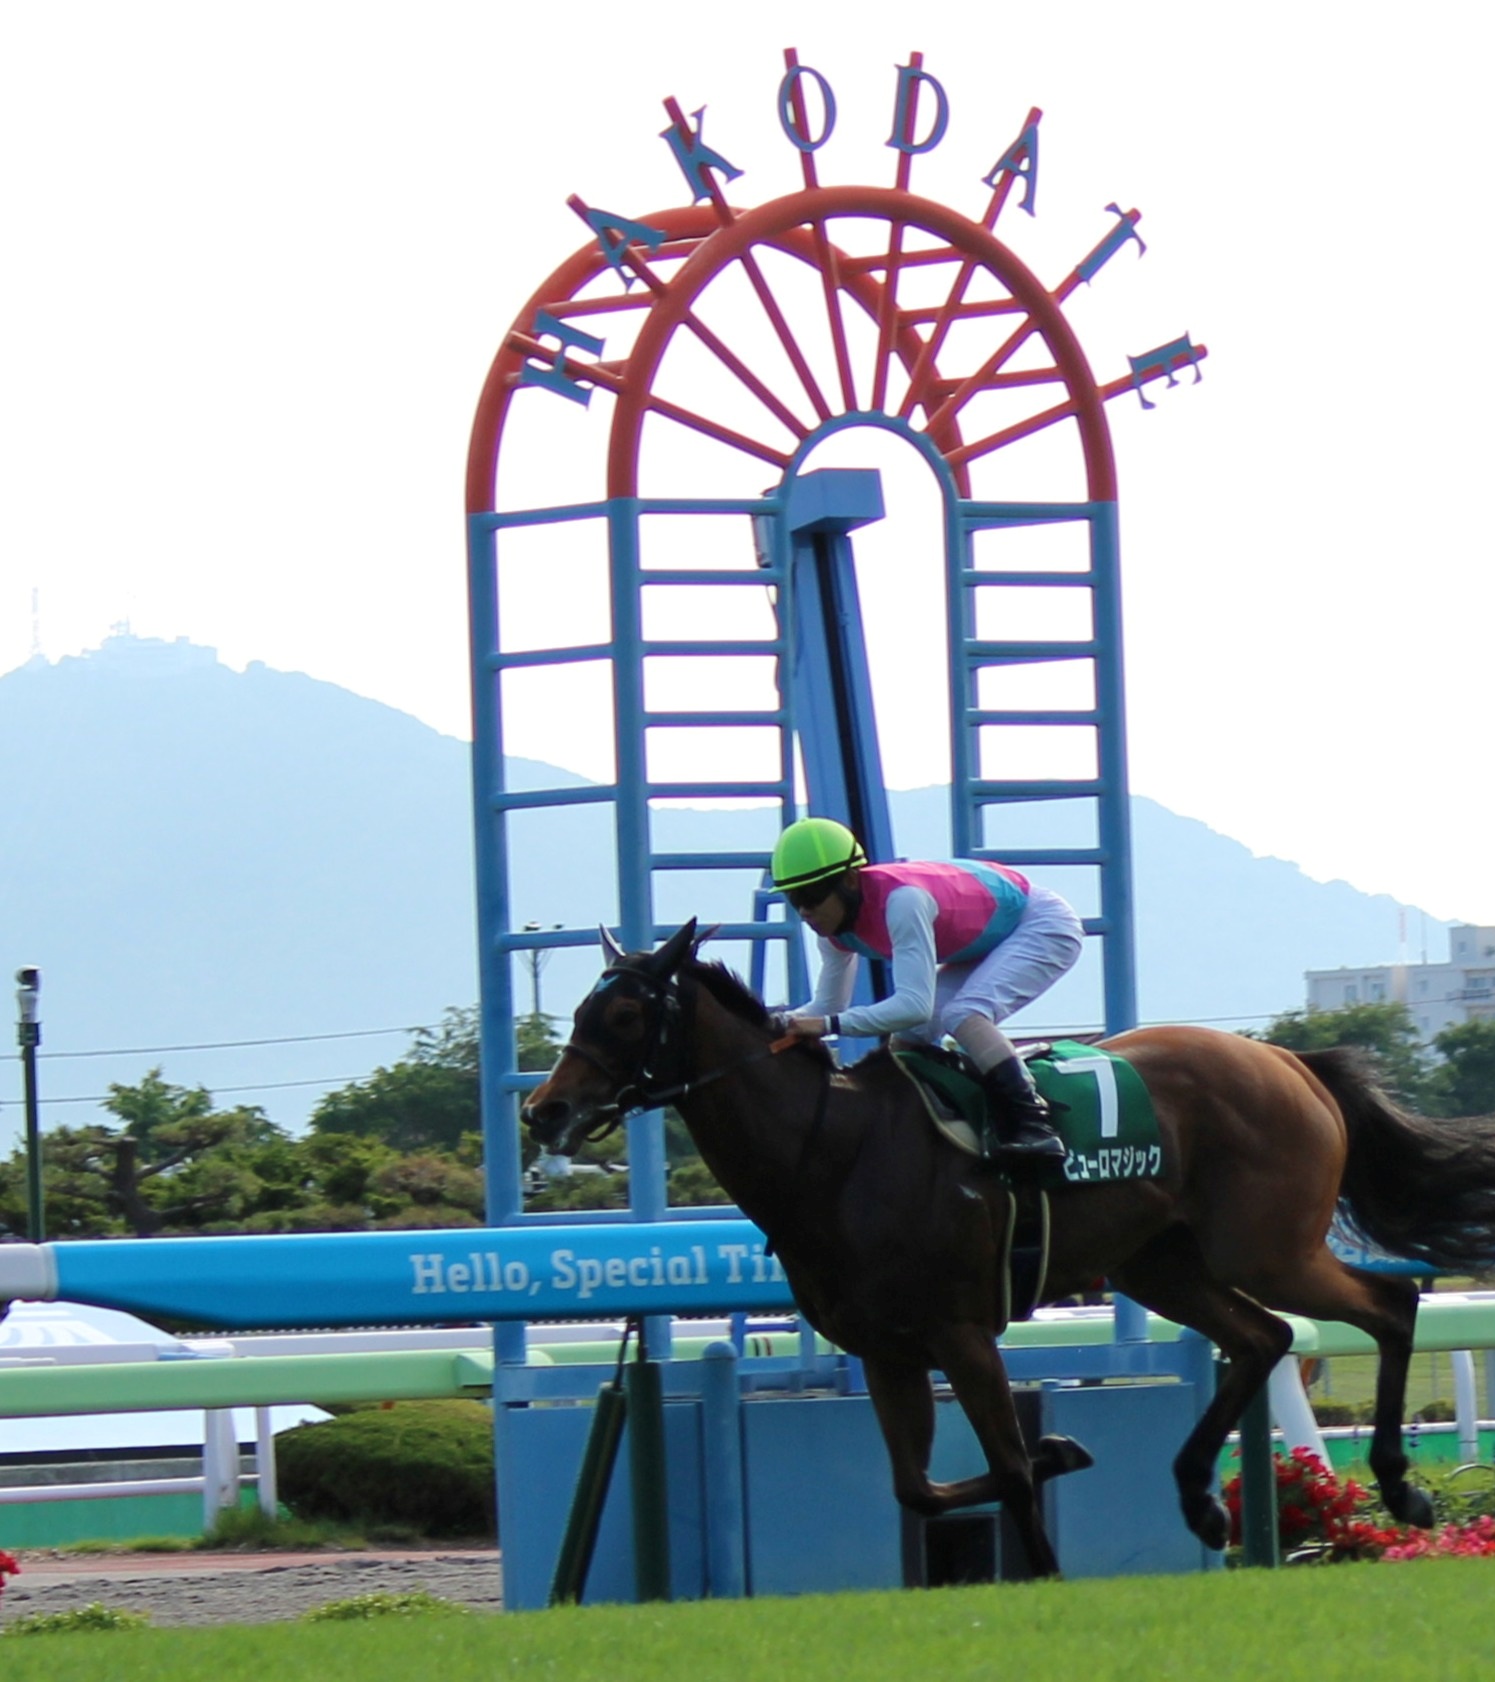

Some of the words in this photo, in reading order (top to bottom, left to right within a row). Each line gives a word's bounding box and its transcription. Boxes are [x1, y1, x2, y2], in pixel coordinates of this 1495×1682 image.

[516, 64, 1205, 411] HAKODATE
[1053, 1055, 1119, 1137] 7
[409, 1252, 541, 1296] Hello,
[550, 1245, 710, 1299] Special
